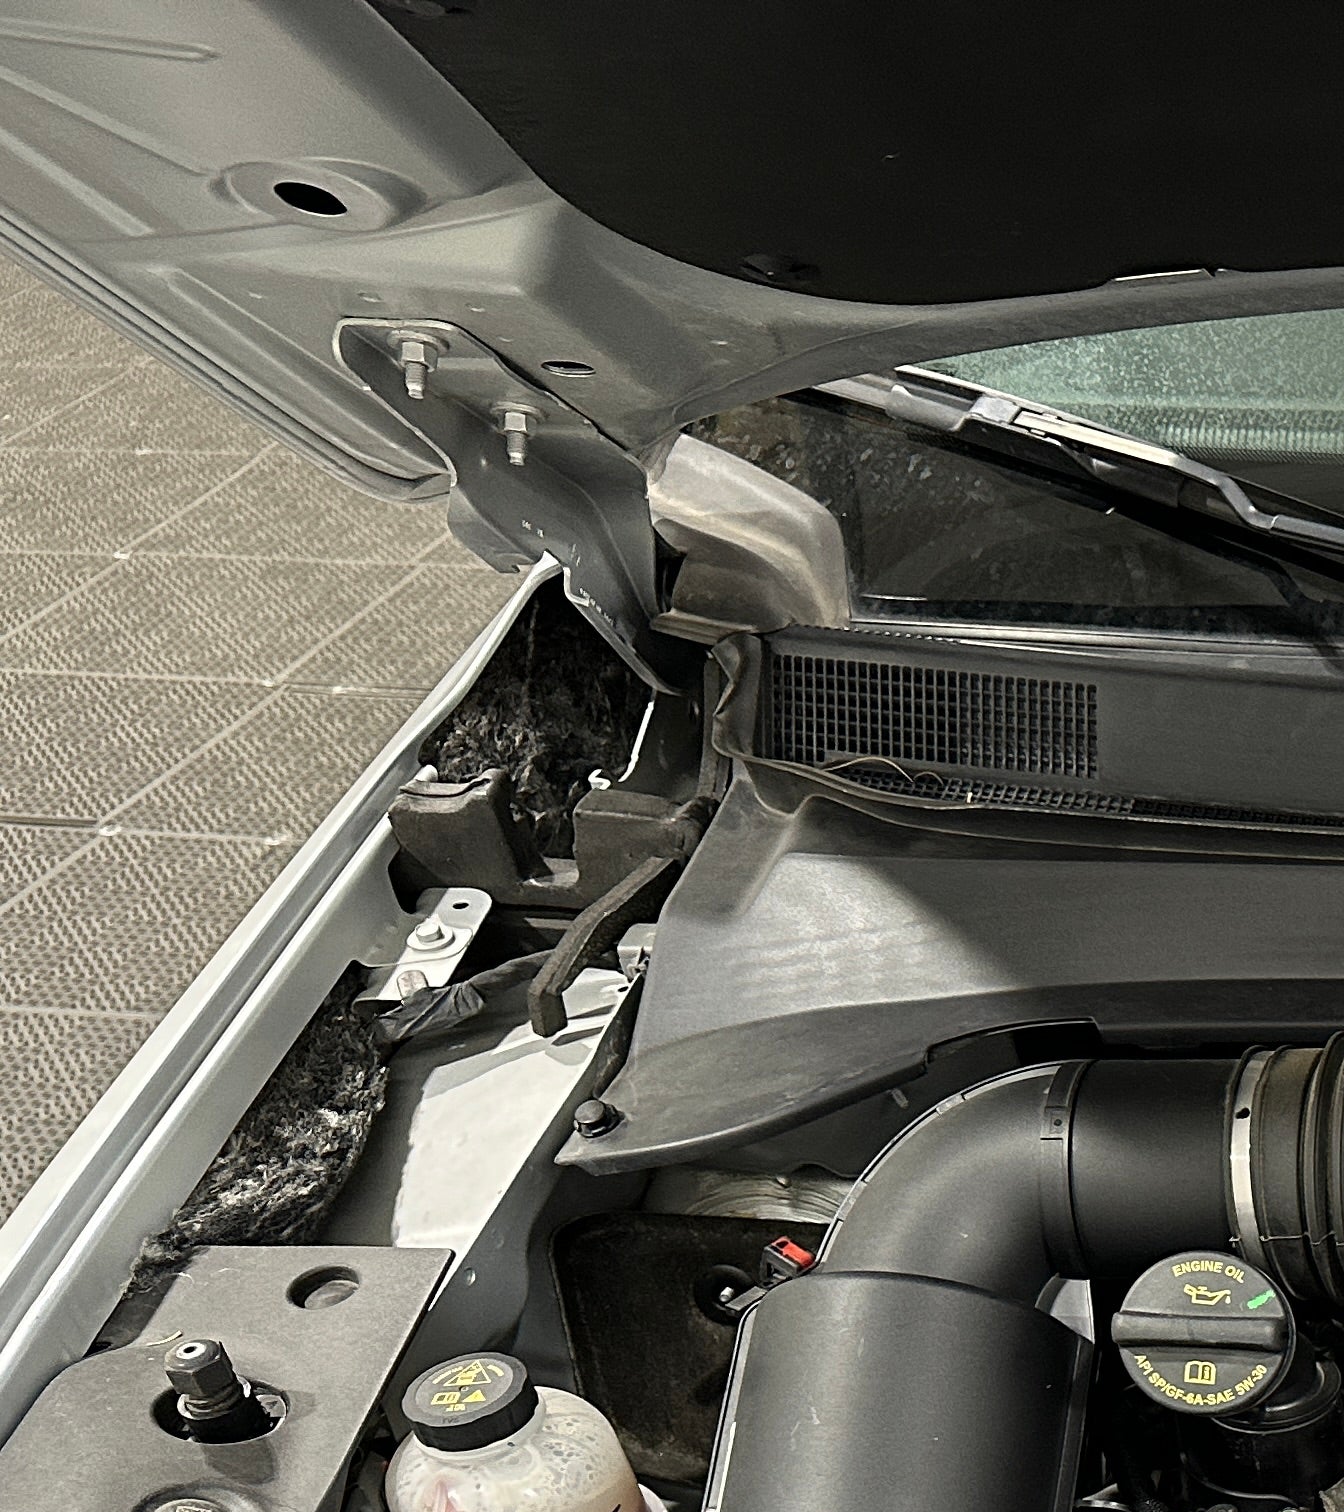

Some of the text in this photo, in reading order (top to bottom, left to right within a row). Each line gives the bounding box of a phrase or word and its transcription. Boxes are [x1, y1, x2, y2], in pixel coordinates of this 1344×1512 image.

[1171, 1260, 1245, 1284] ENGINE OIL
[1133, 1355, 1154, 1376] API
[1234, 1364, 1268, 1396] 5W-30
